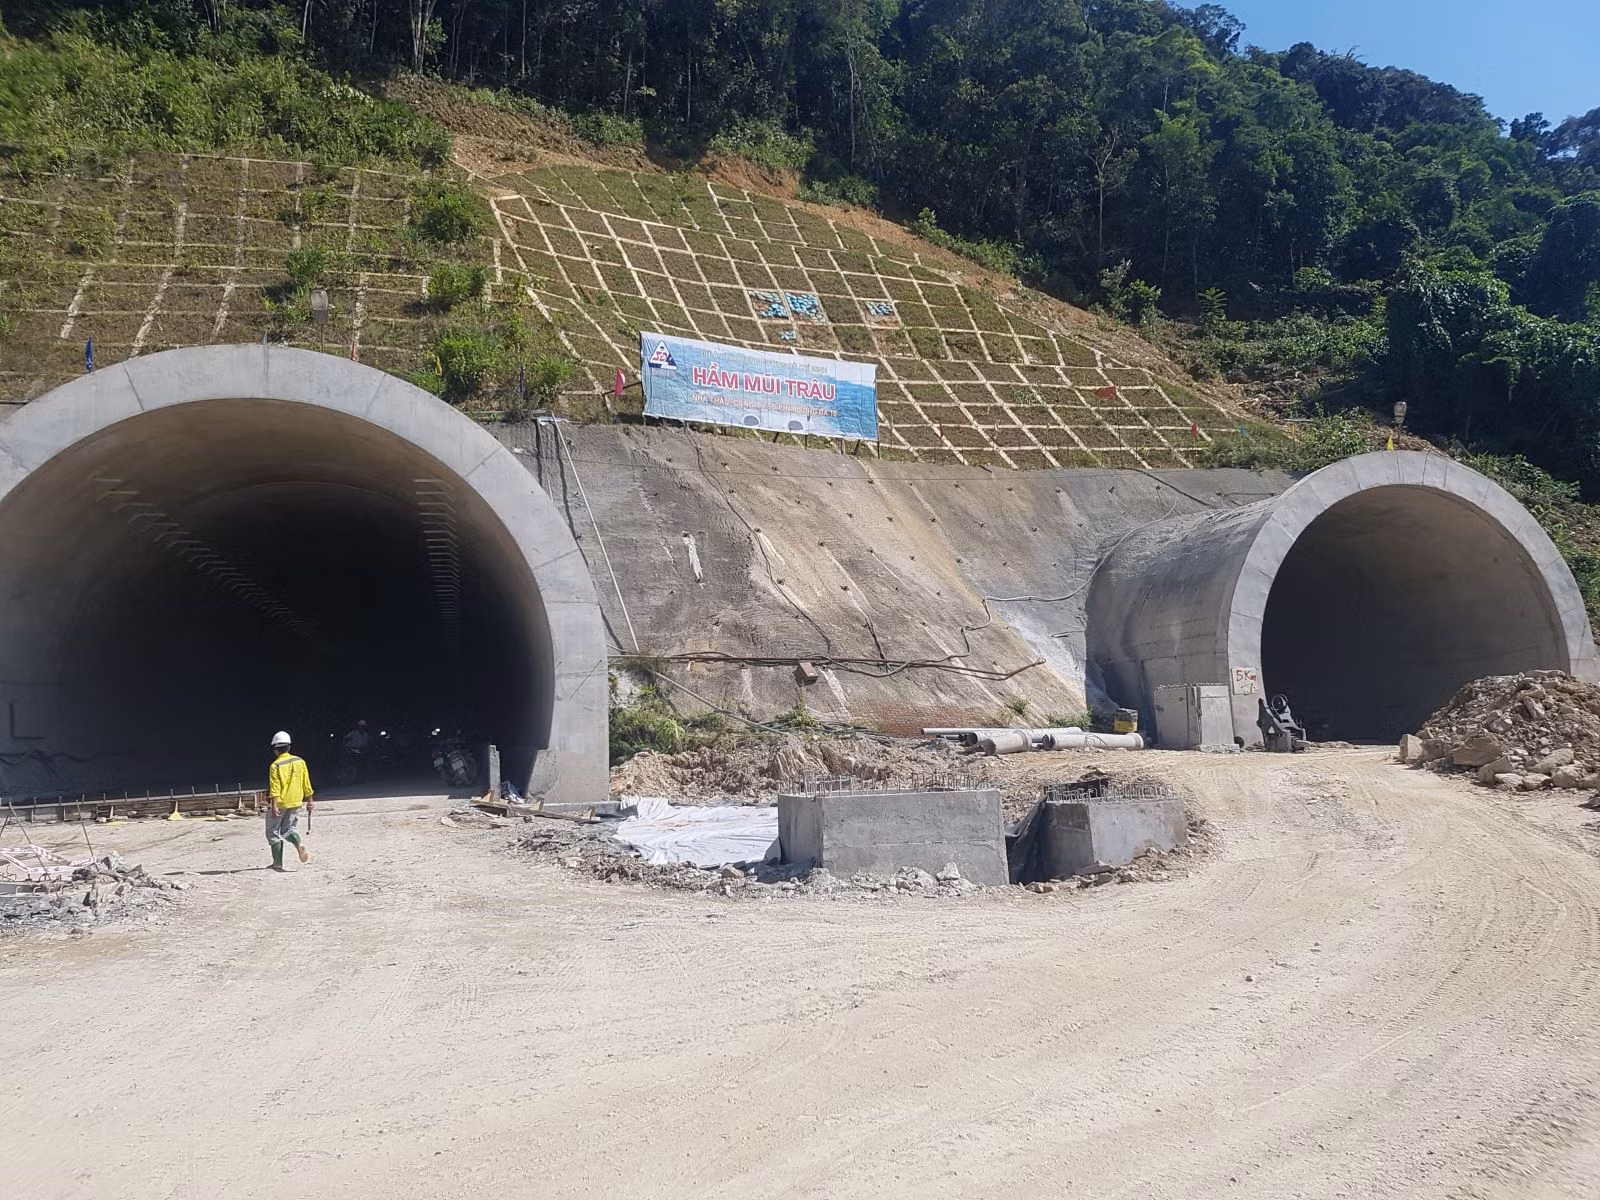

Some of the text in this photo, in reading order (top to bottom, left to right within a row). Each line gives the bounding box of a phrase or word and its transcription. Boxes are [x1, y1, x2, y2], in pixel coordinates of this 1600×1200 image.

[693, 362, 739, 390] HẦM
[744, 372, 781, 395] MŨI
[785, 377, 836, 401] TRÂU
